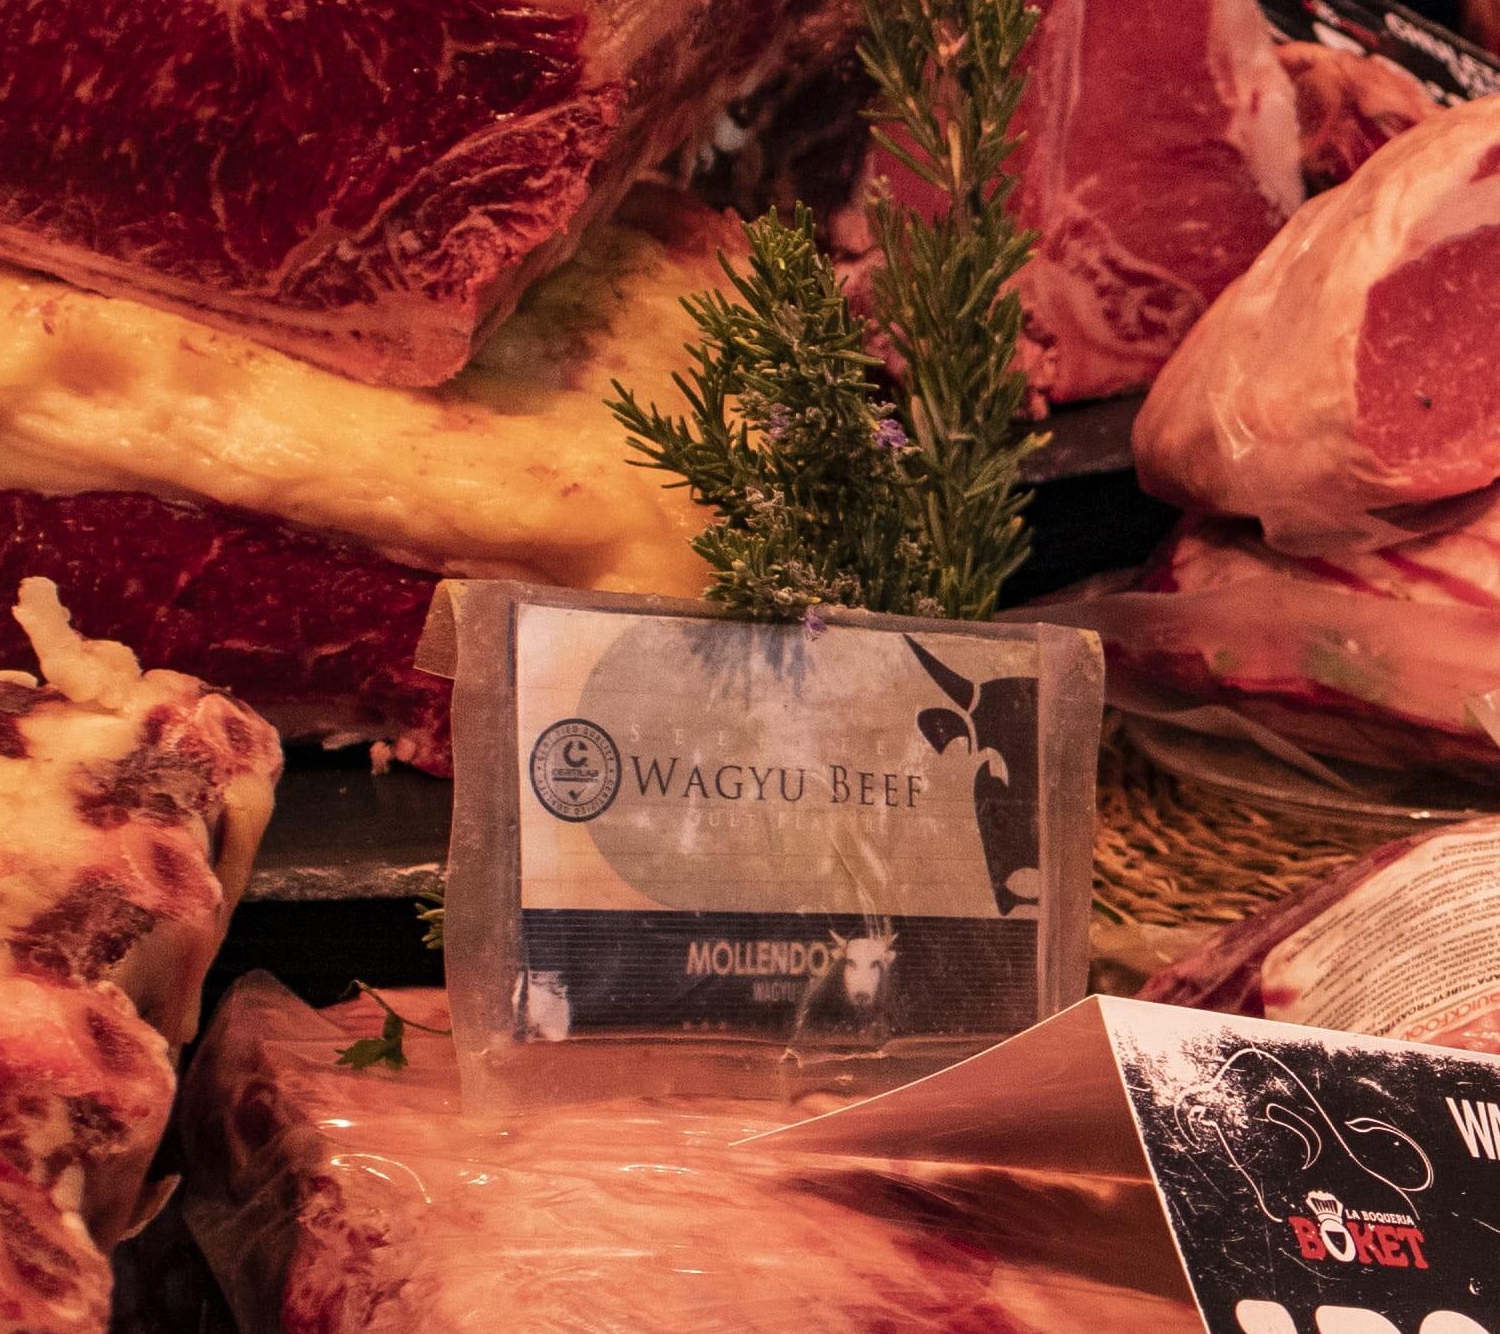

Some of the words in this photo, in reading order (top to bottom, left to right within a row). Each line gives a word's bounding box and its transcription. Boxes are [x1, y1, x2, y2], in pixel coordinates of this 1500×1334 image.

[686, 940, 829, 976] MOLLENDO
[1360, 1210, 1415, 1226] BOQUERIA
[1288, 1215, 1430, 1270] BOKET
